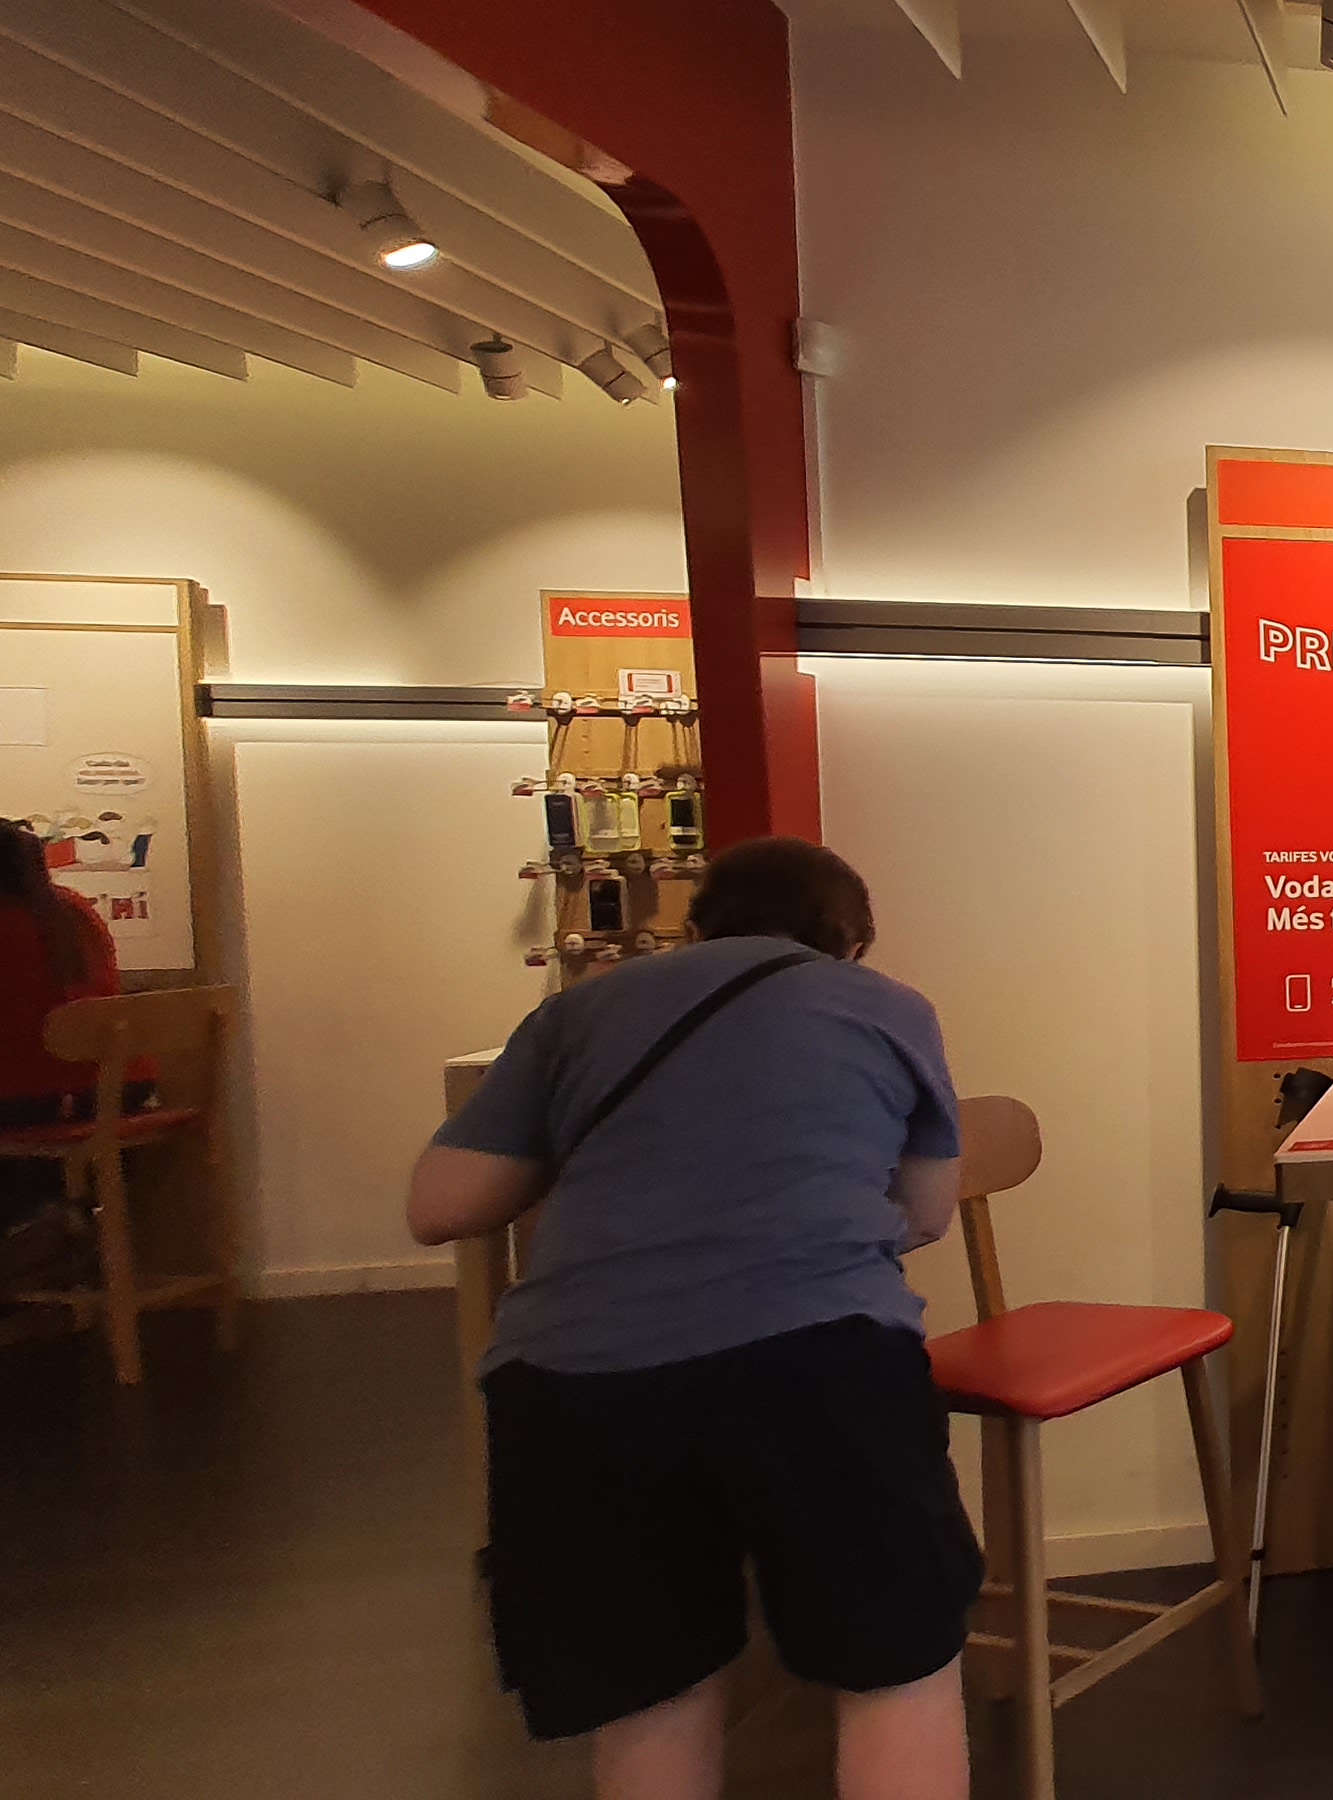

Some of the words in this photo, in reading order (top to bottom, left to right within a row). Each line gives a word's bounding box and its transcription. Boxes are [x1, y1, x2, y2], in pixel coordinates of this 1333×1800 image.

[558, 607, 680, 628] Accessoris
[1263, 851, 1318, 863] TARIFES
[1267, 905, 1325, 931] Més
